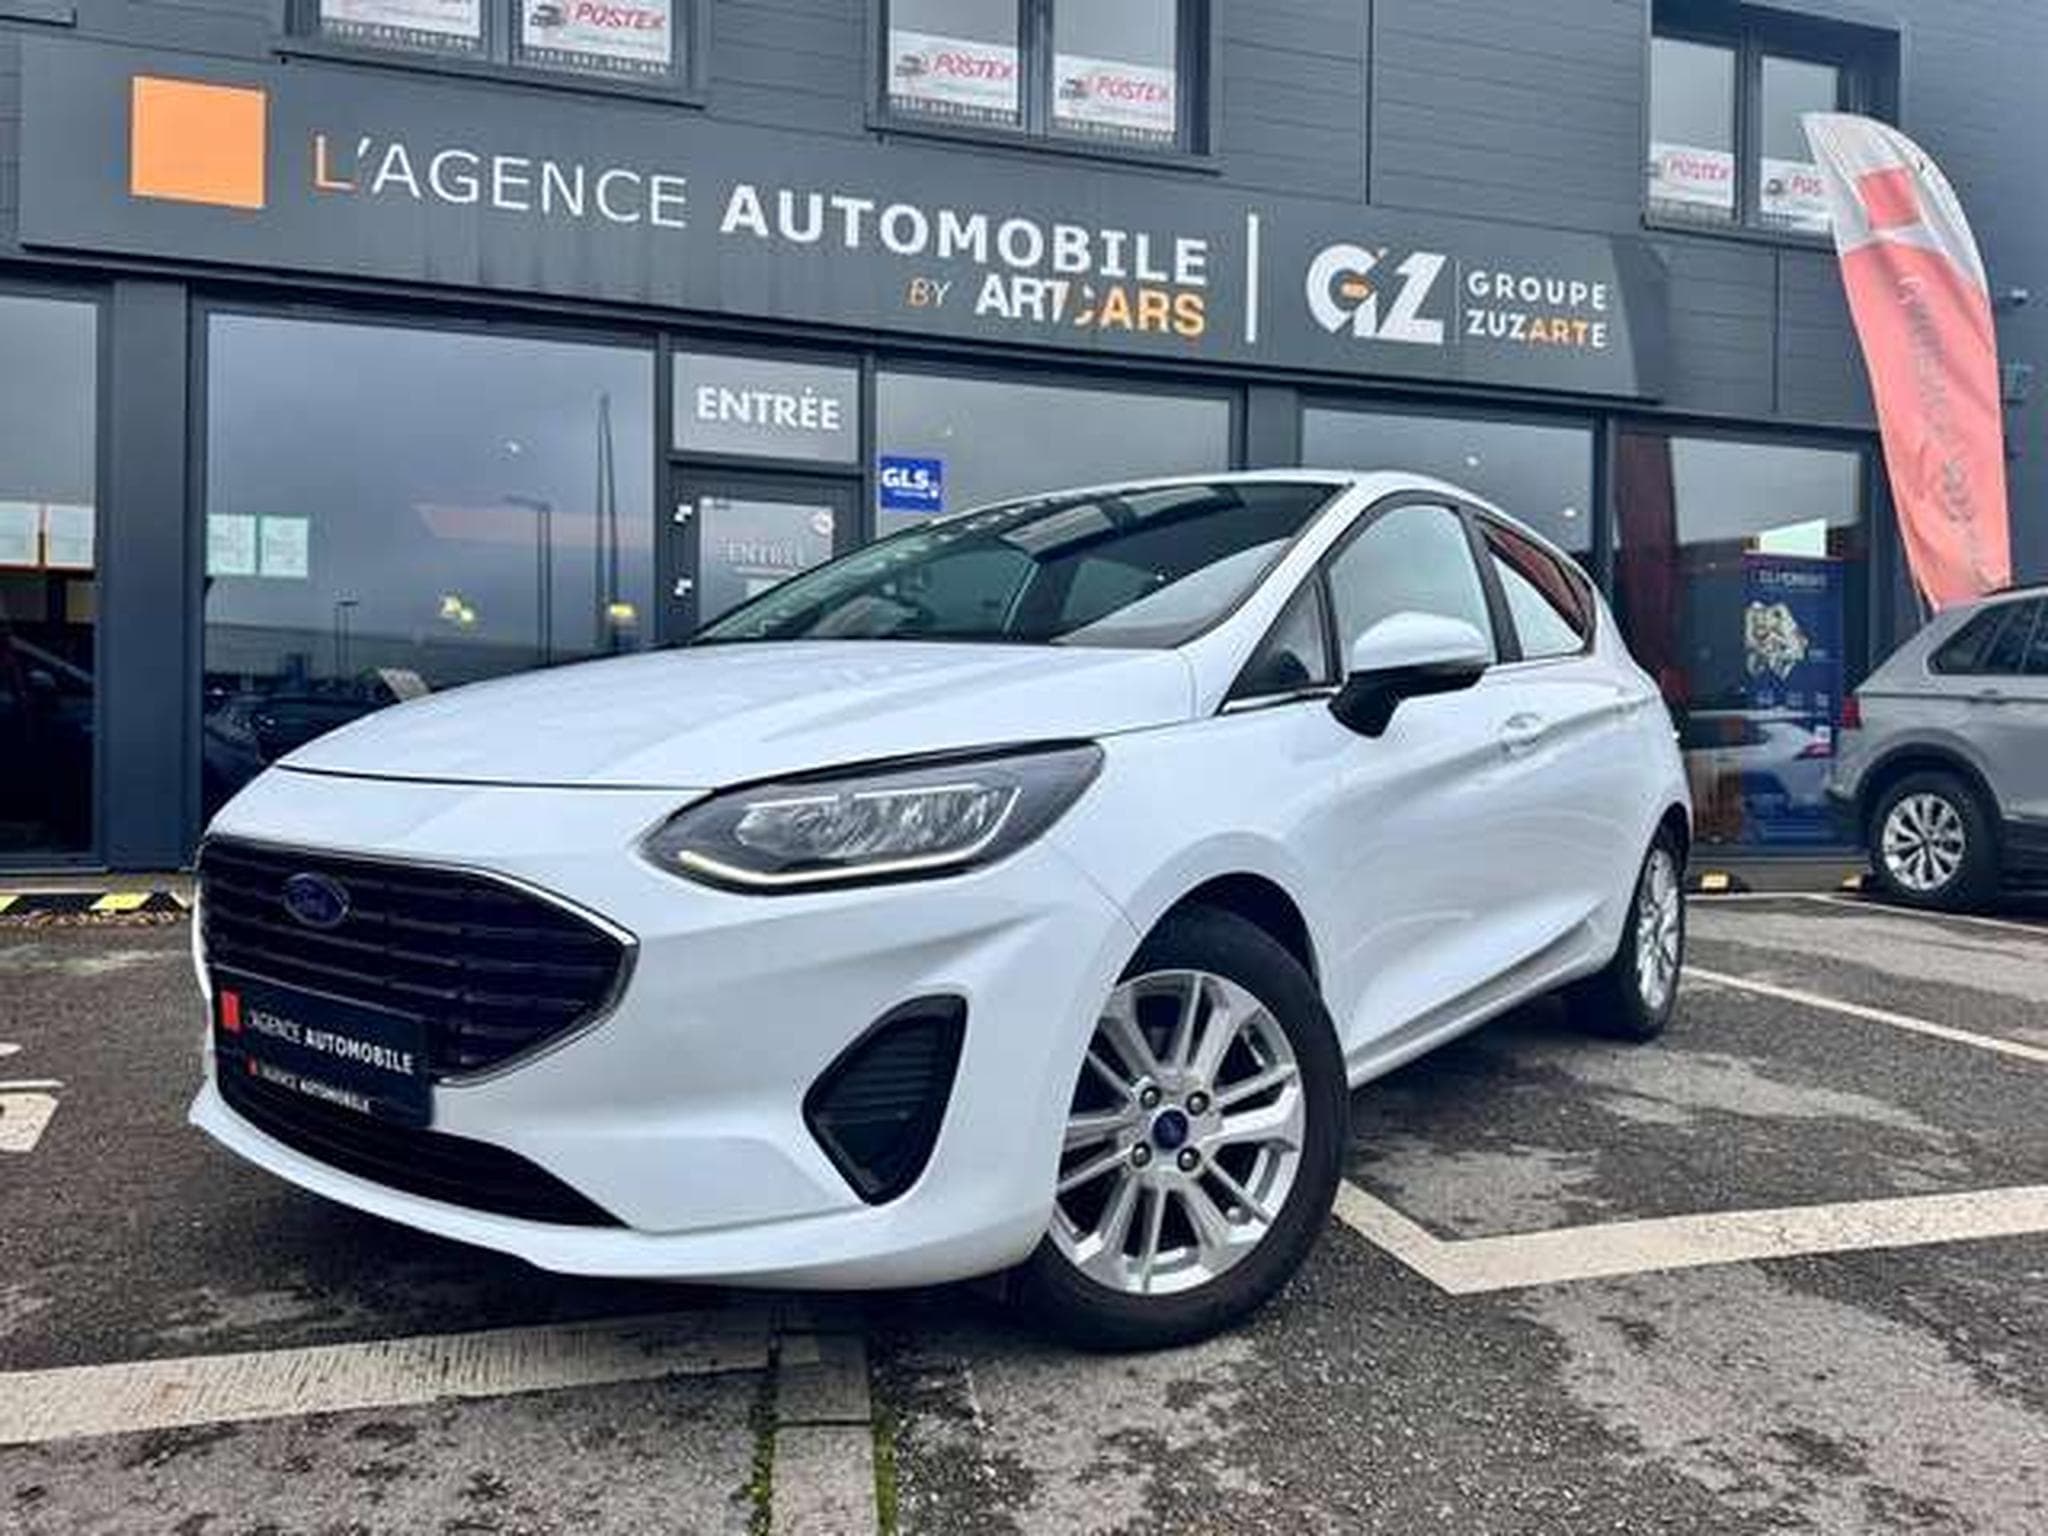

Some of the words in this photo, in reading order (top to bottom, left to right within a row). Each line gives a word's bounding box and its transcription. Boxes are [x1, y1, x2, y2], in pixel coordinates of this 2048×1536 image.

[313, 133, 687, 229] L'AGENCE
[720, 183, 1208, 286] AUTOMOBILE
[908, 275, 951, 307] BY
[974, 272, 1206, 337] ARTCARS
[1466, 270, 1609, 311] GROUPE
[1465, 308, 1608, 349] ZUZARTE
[696, 385, 841, 430] ENTRÉE
[304, 1027, 414, 1076] AUTOMOBILE
